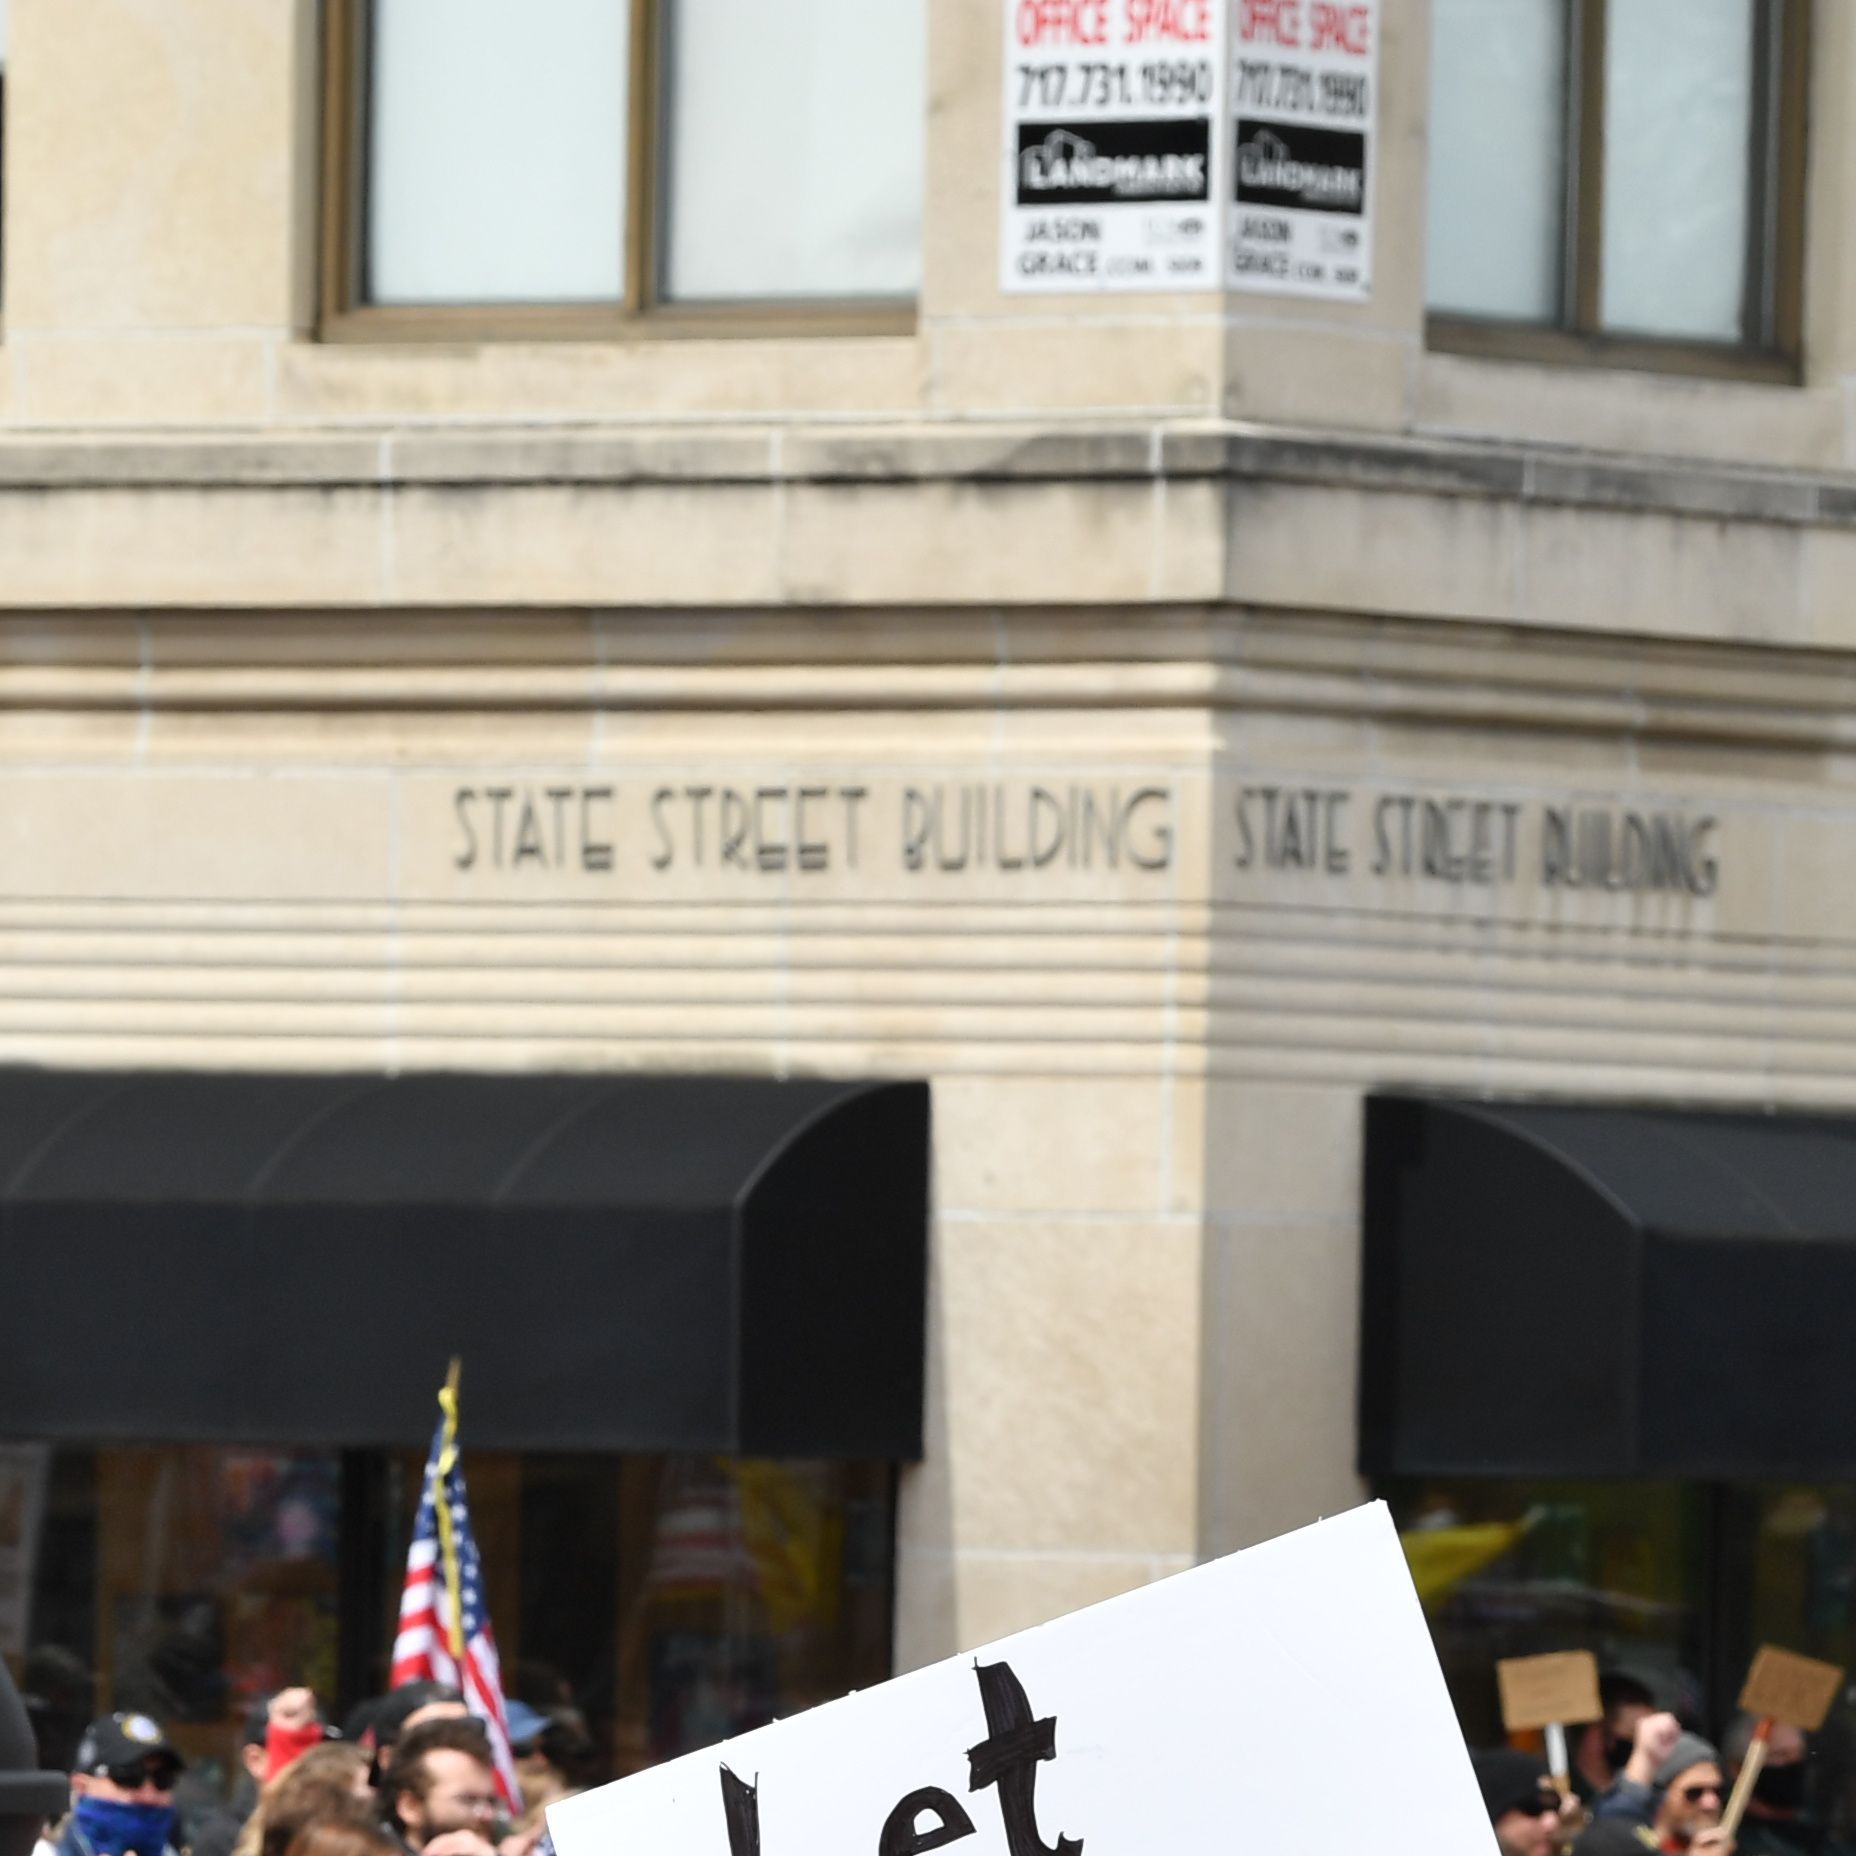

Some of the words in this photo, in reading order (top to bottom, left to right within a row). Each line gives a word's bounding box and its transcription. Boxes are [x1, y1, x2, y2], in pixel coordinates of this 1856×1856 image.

[1017, 0, 1109, 44] OFFICE
[1123, 0, 1211, 43] SPACE
[1239, 0, 1300, 48] OFFICE
[1308, 4, 1369, 54] SPACE
[1016, 62, 1212, 107] 717.731.1990
[1020, 153, 1206, 190] LANDMARK
[1022, 216, 1101, 243] JASON
[1016, 249, 1098, 277] GRACE
[453, 786, 614, 872] STATE
[649, 786, 868, 872] STREET
[902, 786, 1172, 872] BUILDING
[1235, 787, 1352, 873] STATE
[1371, 793, 1521, 885] STREET
[1539, 800, 1718, 897] BUILDING
